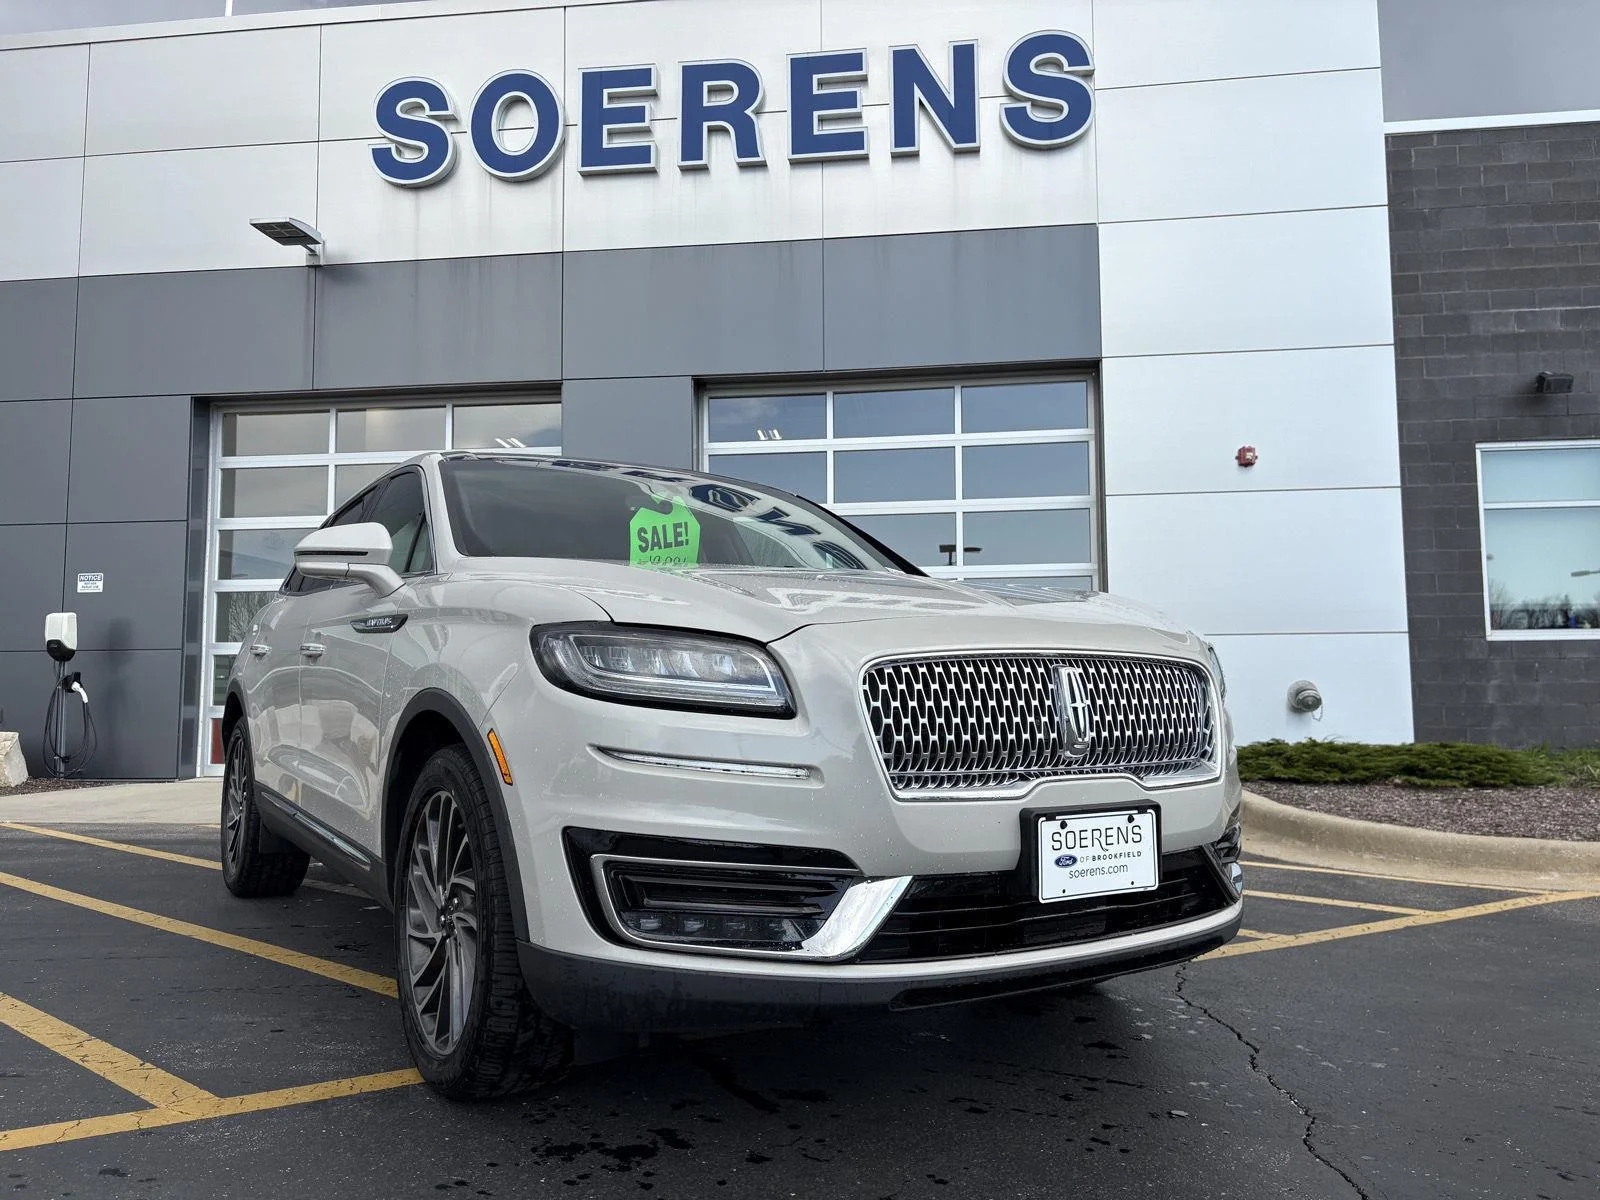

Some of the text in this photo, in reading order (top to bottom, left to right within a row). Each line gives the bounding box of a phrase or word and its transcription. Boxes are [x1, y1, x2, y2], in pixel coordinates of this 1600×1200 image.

[369, 29, 1096, 187] SOERENS
[637, 521, 689, 553] SALE!
[1052, 825, 1142, 851] SOERENS
[1091, 850, 1142, 862] BROOKFIELD
[1068, 864, 1128, 879] soerens.com
